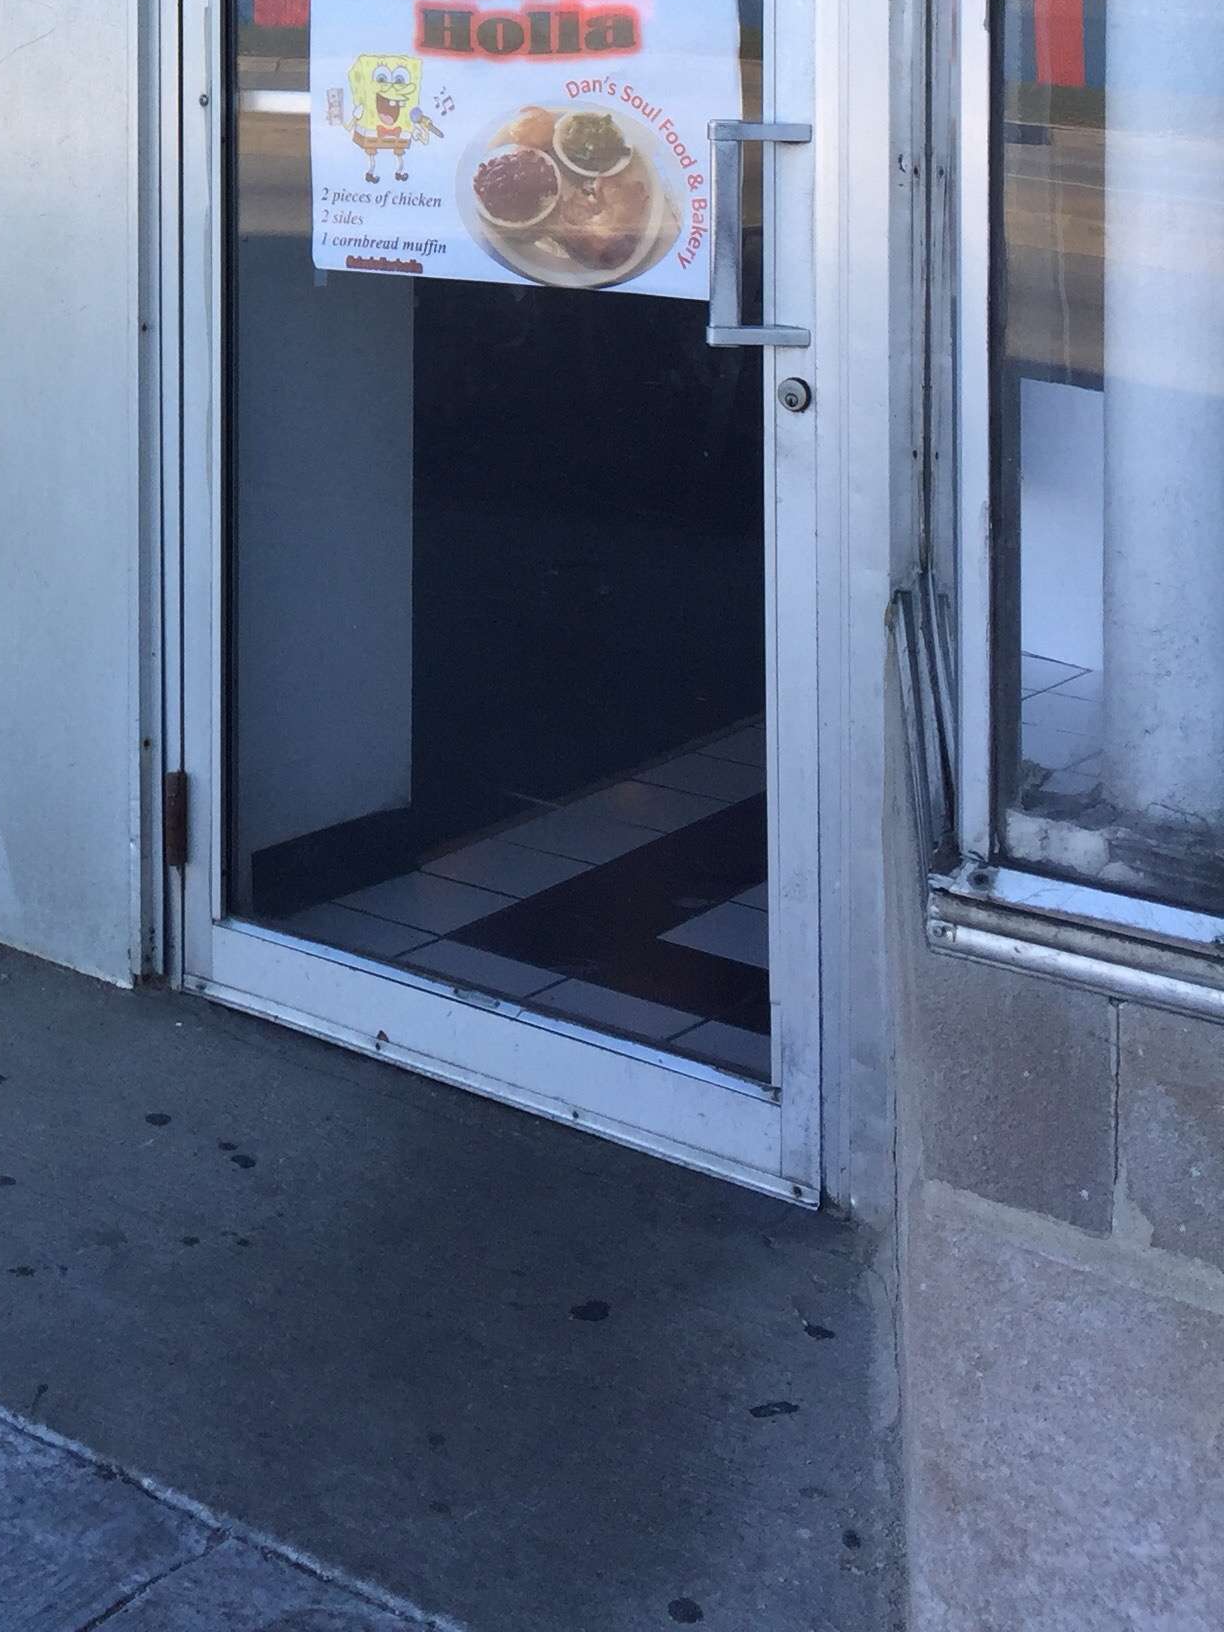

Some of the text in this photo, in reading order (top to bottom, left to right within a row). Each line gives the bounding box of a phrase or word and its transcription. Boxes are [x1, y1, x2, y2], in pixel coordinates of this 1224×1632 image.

[418, 7, 636, 54] Holla
[565, 76, 708, 270] Dan's Soul Food & Bakery
[321, 187, 442, 208] 2 pieces of chicken
[321, 209, 364, 225] 2 sides
[321, 232, 447, 256] 1 cornbread muffin
